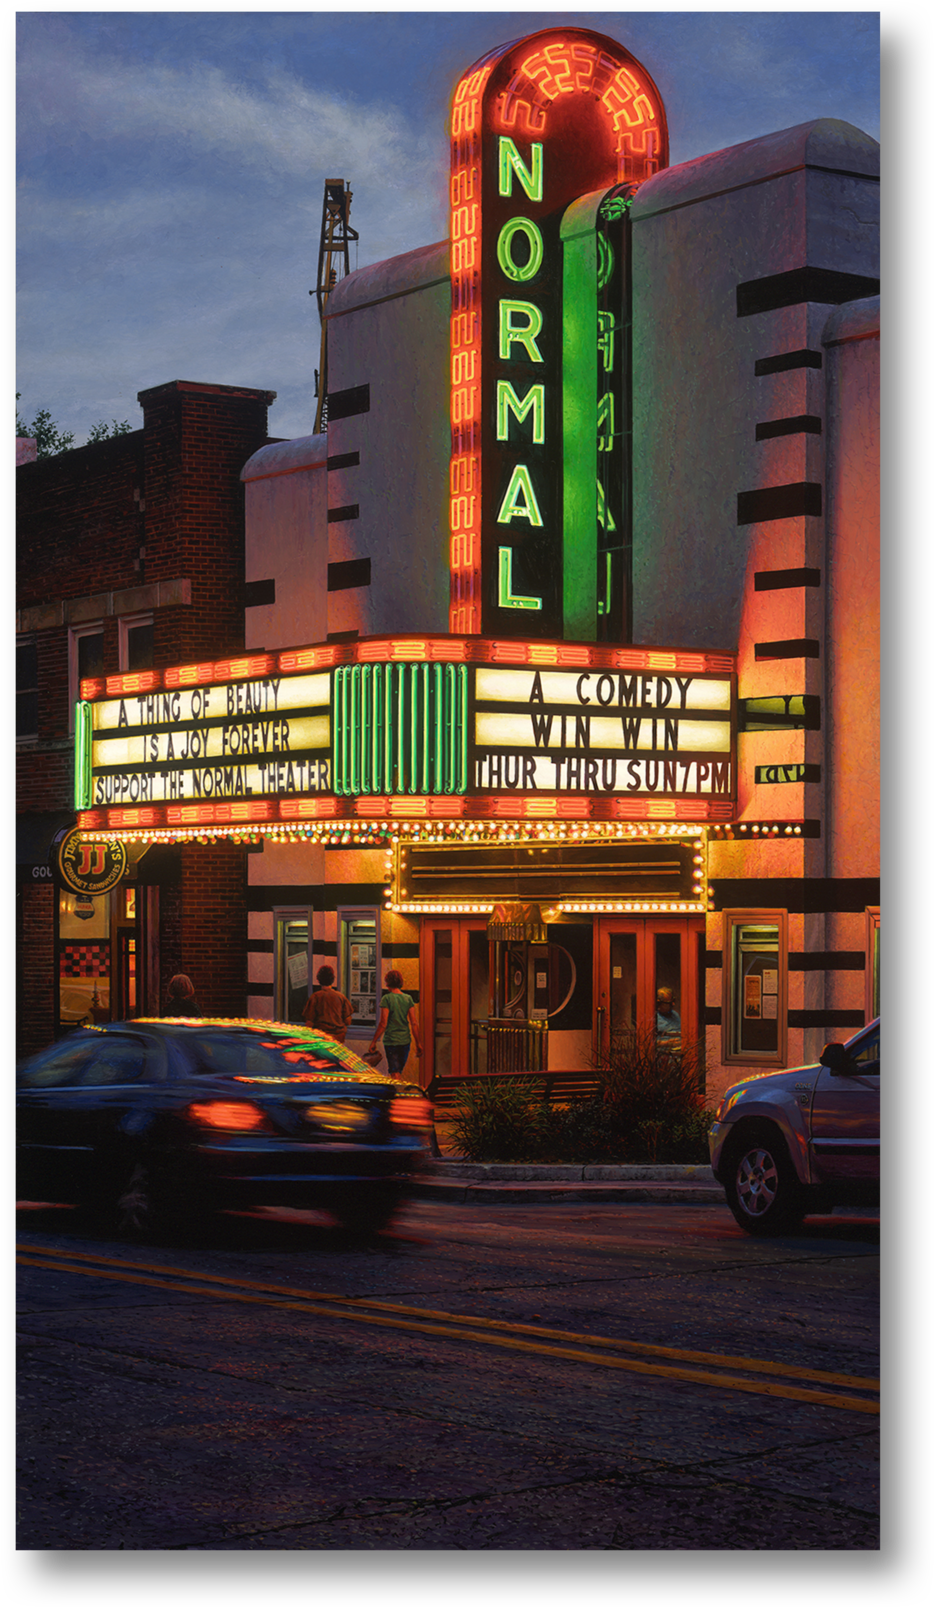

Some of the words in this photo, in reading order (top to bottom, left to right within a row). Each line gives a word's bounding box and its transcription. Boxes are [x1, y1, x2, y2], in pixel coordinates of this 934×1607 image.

[496, 136, 545, 610] NORMAL
[118, 699, 129, 728] A
[137, 692, 182, 726] THING
[191, 688, 211, 720] OF
[226, 678, 281, 716] BEAUTY
[529, 671, 544, 703] A
[576, 673, 694, 710] COMEDY
[143, 734, 159, 763] IS
[166, 734, 175, 761] A
[181, 728, 210, 760] JOY
[222, 719, 290, 755] FOREVER
[531, 714, 591, 748] WIN
[621, 717, 679, 750] WIN
[96, 772, 156, 804] SUPPORT
[161, 769, 184, 801] THE
[192, 764, 252, 798] NORMAL
[258, 759, 329, 793] THEATER
[475, 755, 537, 789] THUR
[551, 756, 617, 792] THRU
[64, 861, 88, 889] GOURMET
[87, 864, 121, 890] SANDWICHES
[78, 844, 108, 875] JJ
